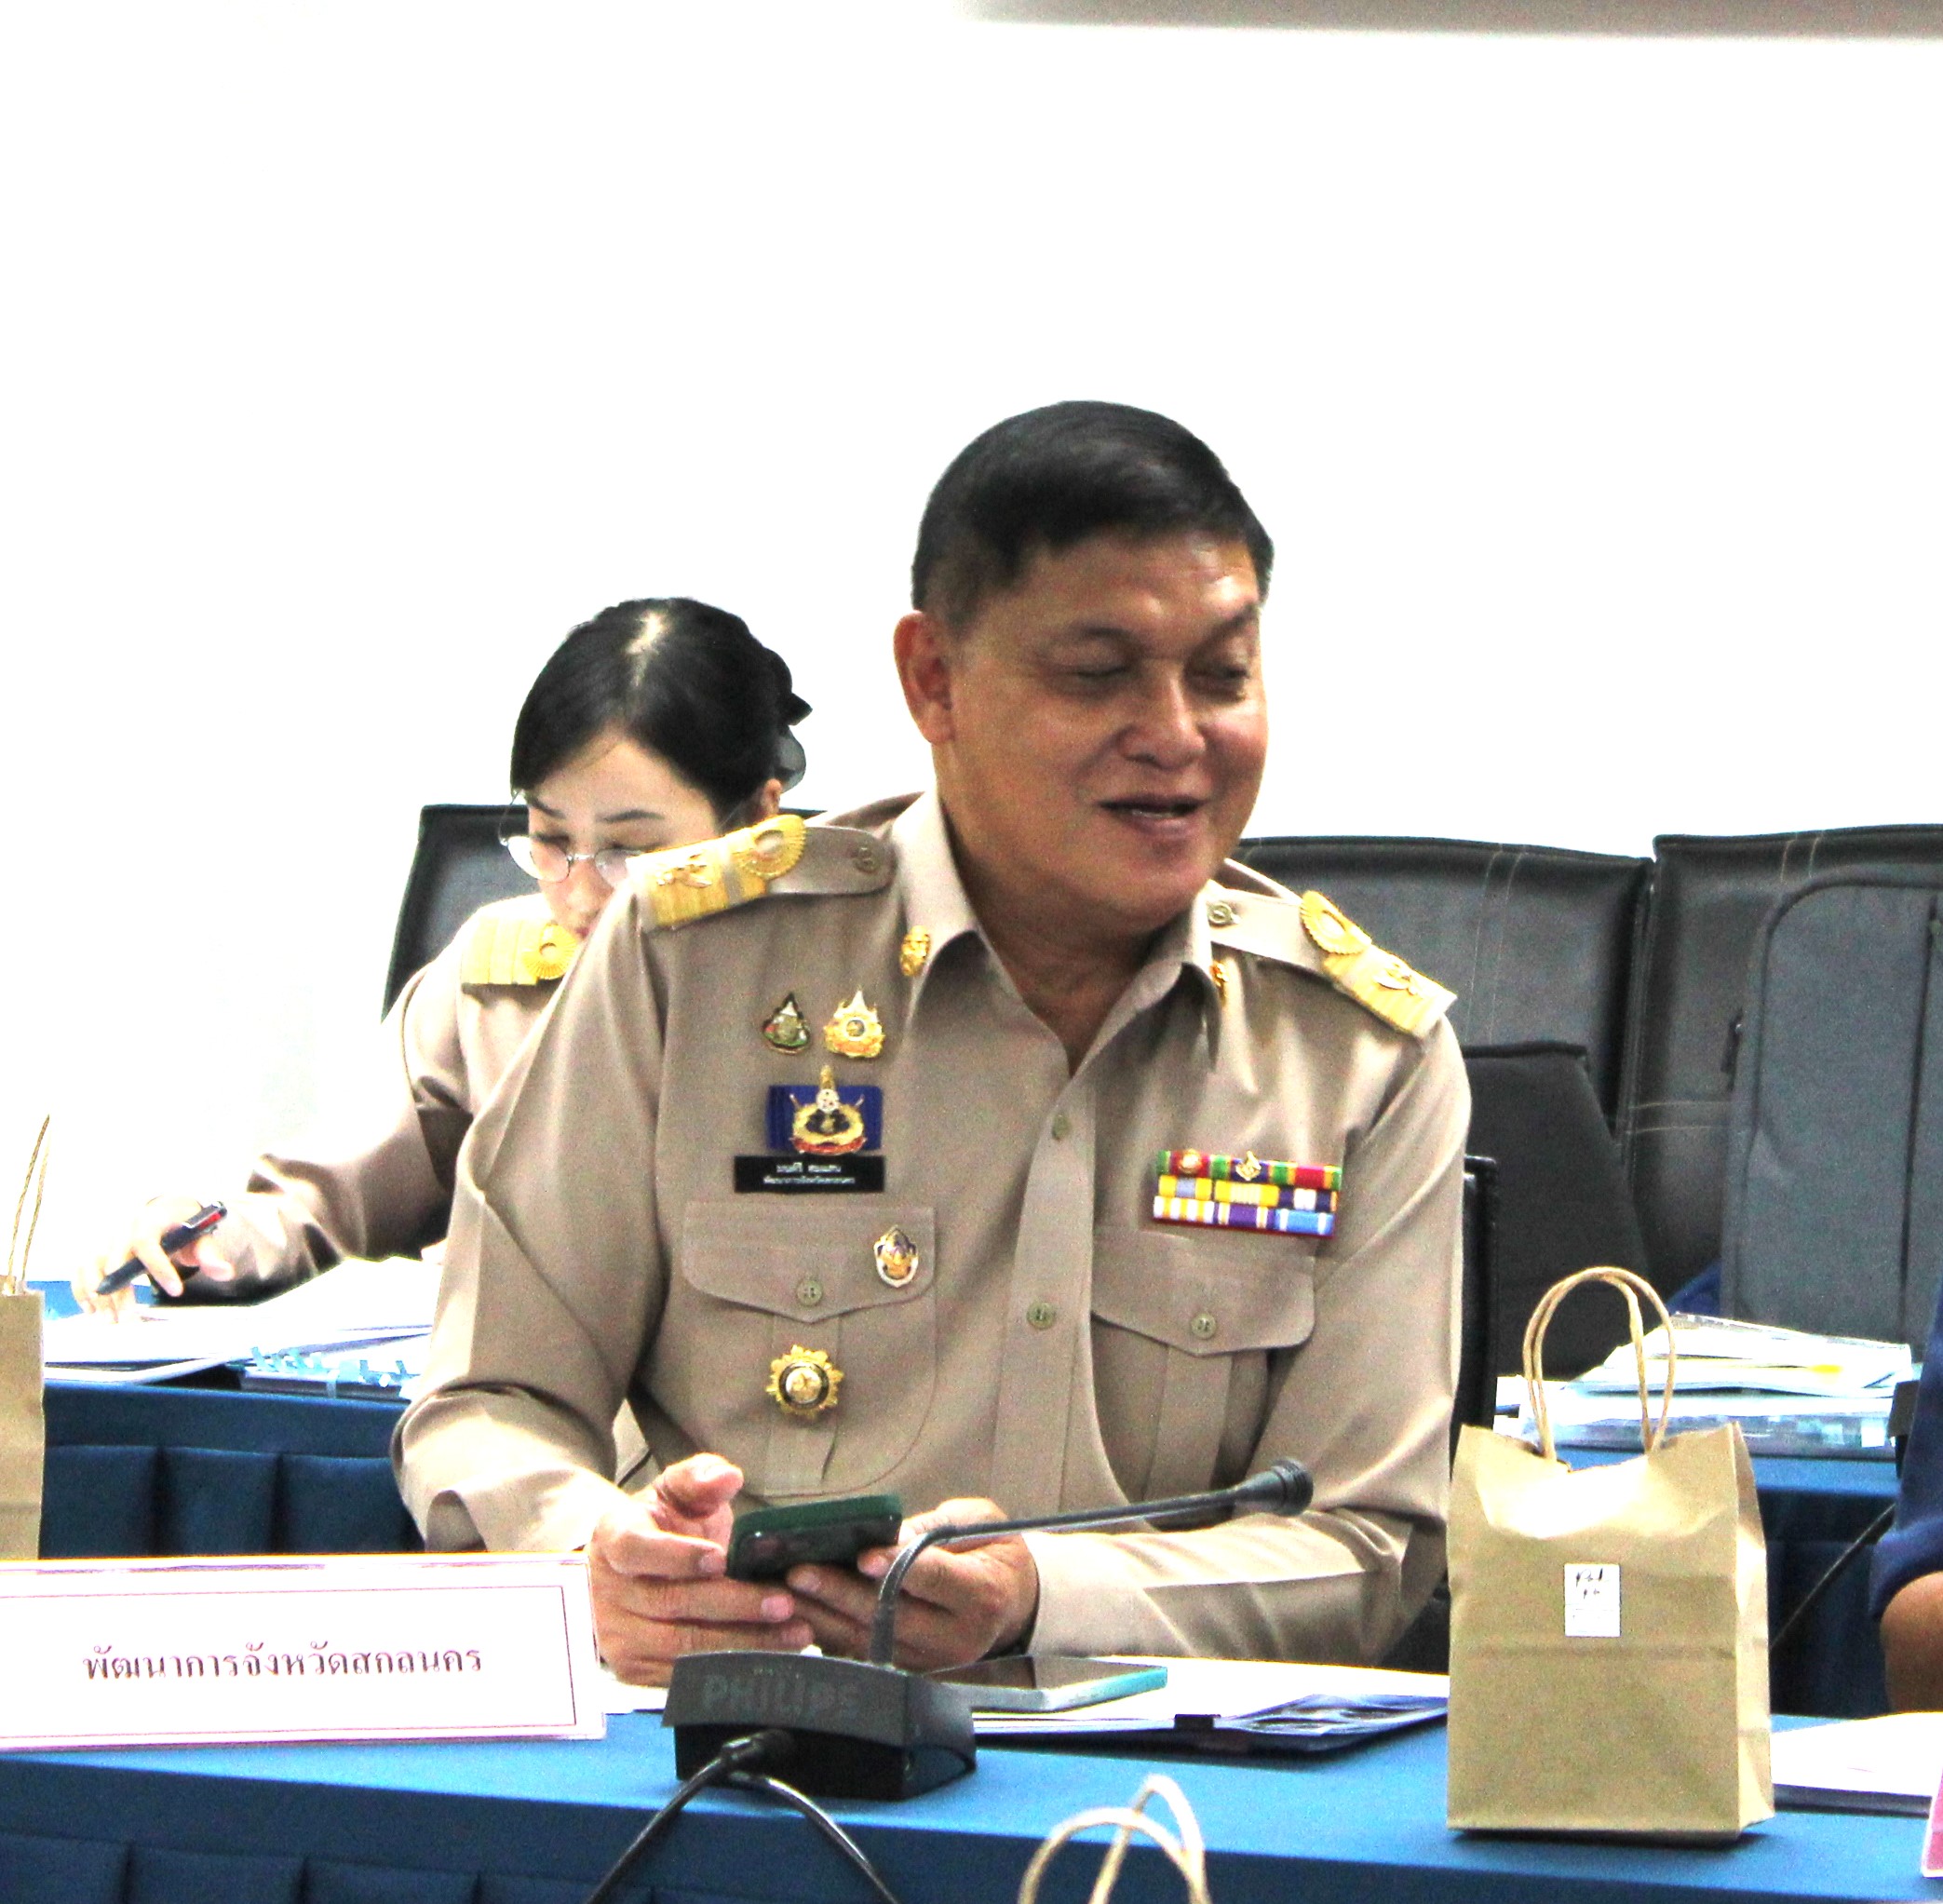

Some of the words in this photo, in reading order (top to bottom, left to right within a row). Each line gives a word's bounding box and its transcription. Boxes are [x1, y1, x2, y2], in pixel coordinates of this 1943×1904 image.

[82, 1641, 482, 1680] พัฒนาการจังหวัดสกลนคร
